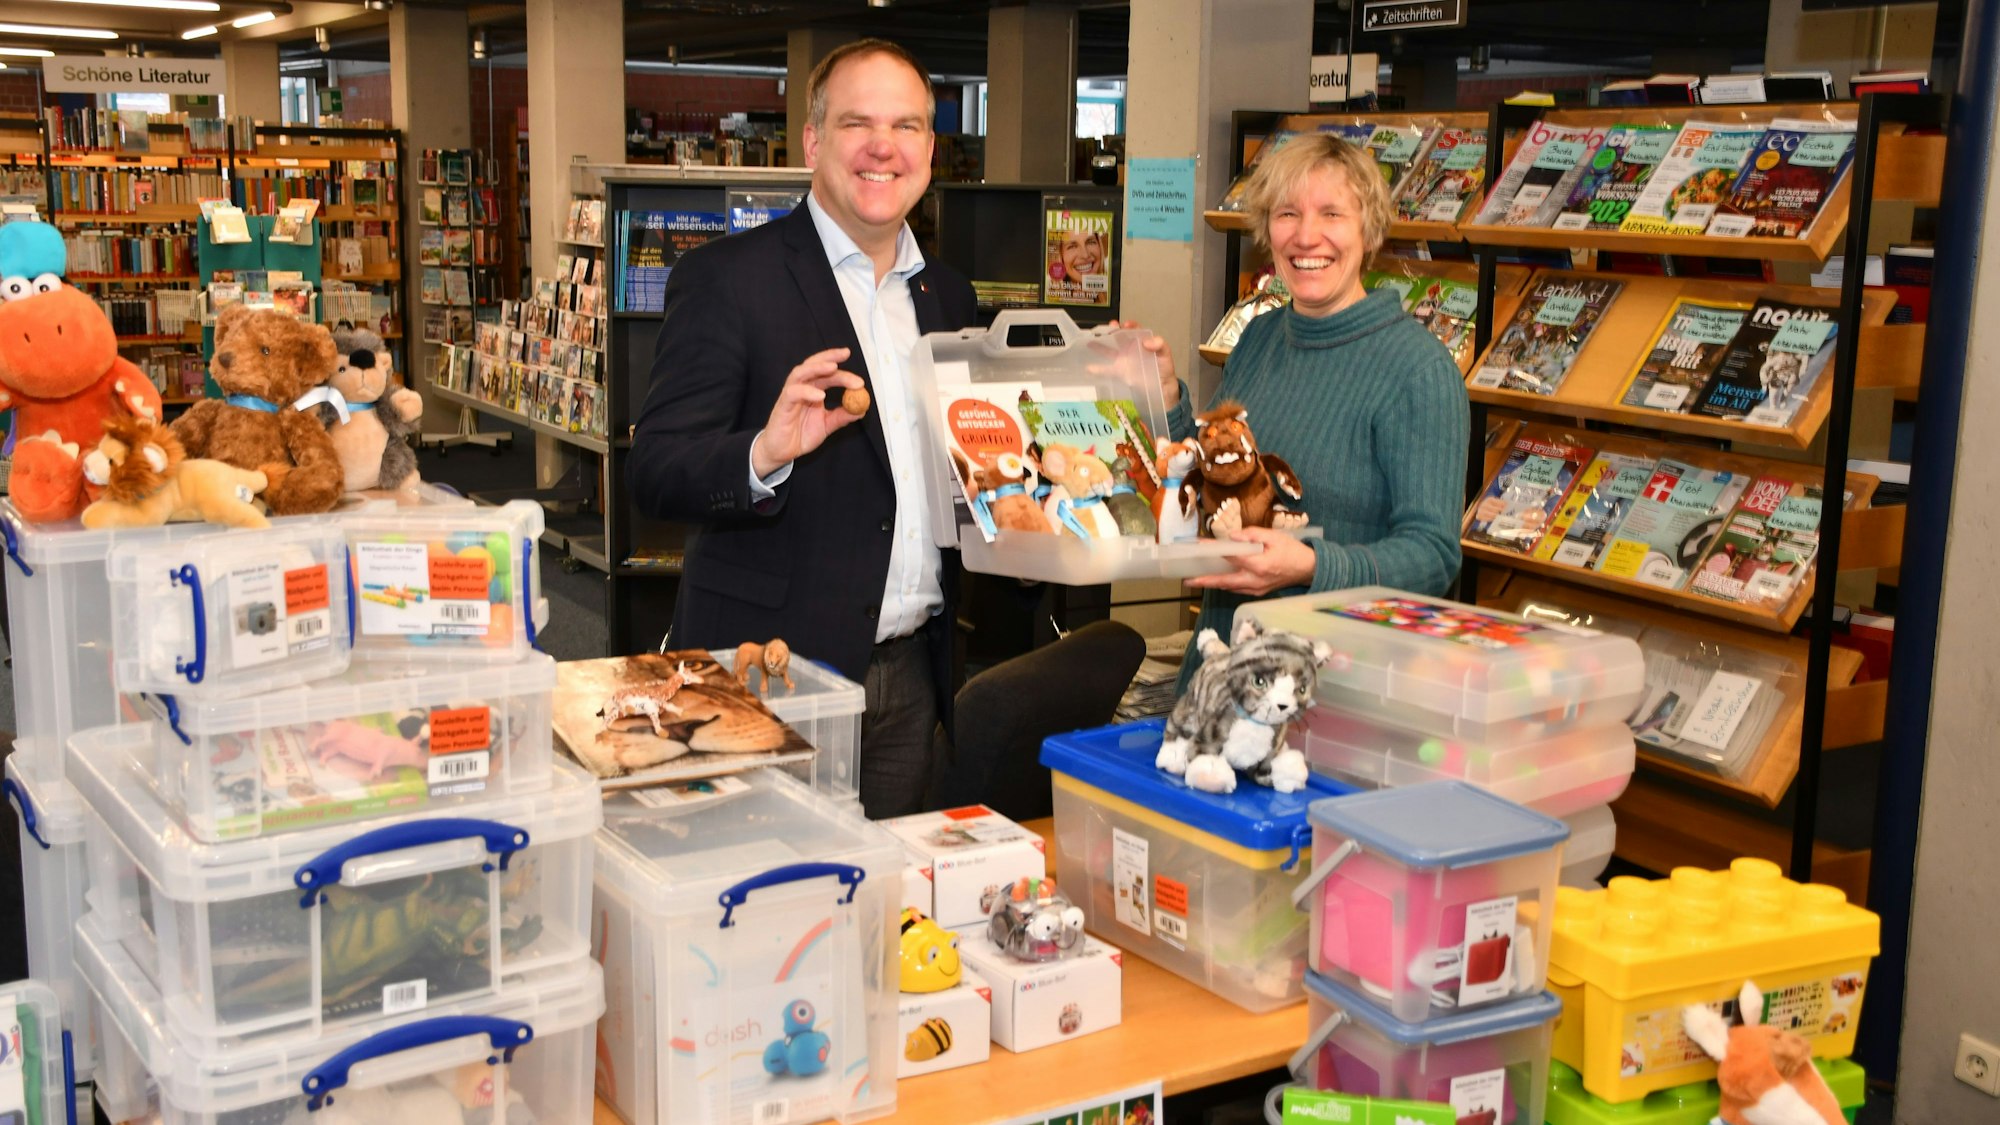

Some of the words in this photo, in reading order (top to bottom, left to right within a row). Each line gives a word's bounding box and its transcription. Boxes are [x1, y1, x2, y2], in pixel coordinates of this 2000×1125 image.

[1382, 7, 1443, 25] Zeitschriften
[62, 65, 133, 83] Schöne
[138, 67, 211, 84] Literatur
[1131, 190, 1145, 199] DVDs
[1146, 190, 1155, 199] und
[1155, 190, 1187, 200] Zeitschriften
[1165, 205, 1185, 213] Wochen
[676, 215, 689, 223] bild
[1714, 383, 1768, 400] Mensch
[1708, 394, 1727, 405] im
[1730, 395, 1751, 410] All
[958, 409, 997, 420] GEFÜHLE
[1057, 408, 1081, 419] DER
[956, 419, 1006, 430] ENTDECKEN
[1515, 439, 1531, 449] DER
[1753, 479, 1789, 500] WOHN
[1744, 493, 1778, 513] IDEE
[433, 561, 465, 569] Ausleihe
[468, 561, 484, 569] und
[432, 573, 469, 582] Rückgabe
[453, 585, 488, 593] Personal
[433, 716, 467, 726] Ausleihe
[469, 714, 485, 722] und
[432, 728, 469, 738] Rückgabe
[431, 742, 452, 751] beim
[453, 738, 487, 748] Personal
